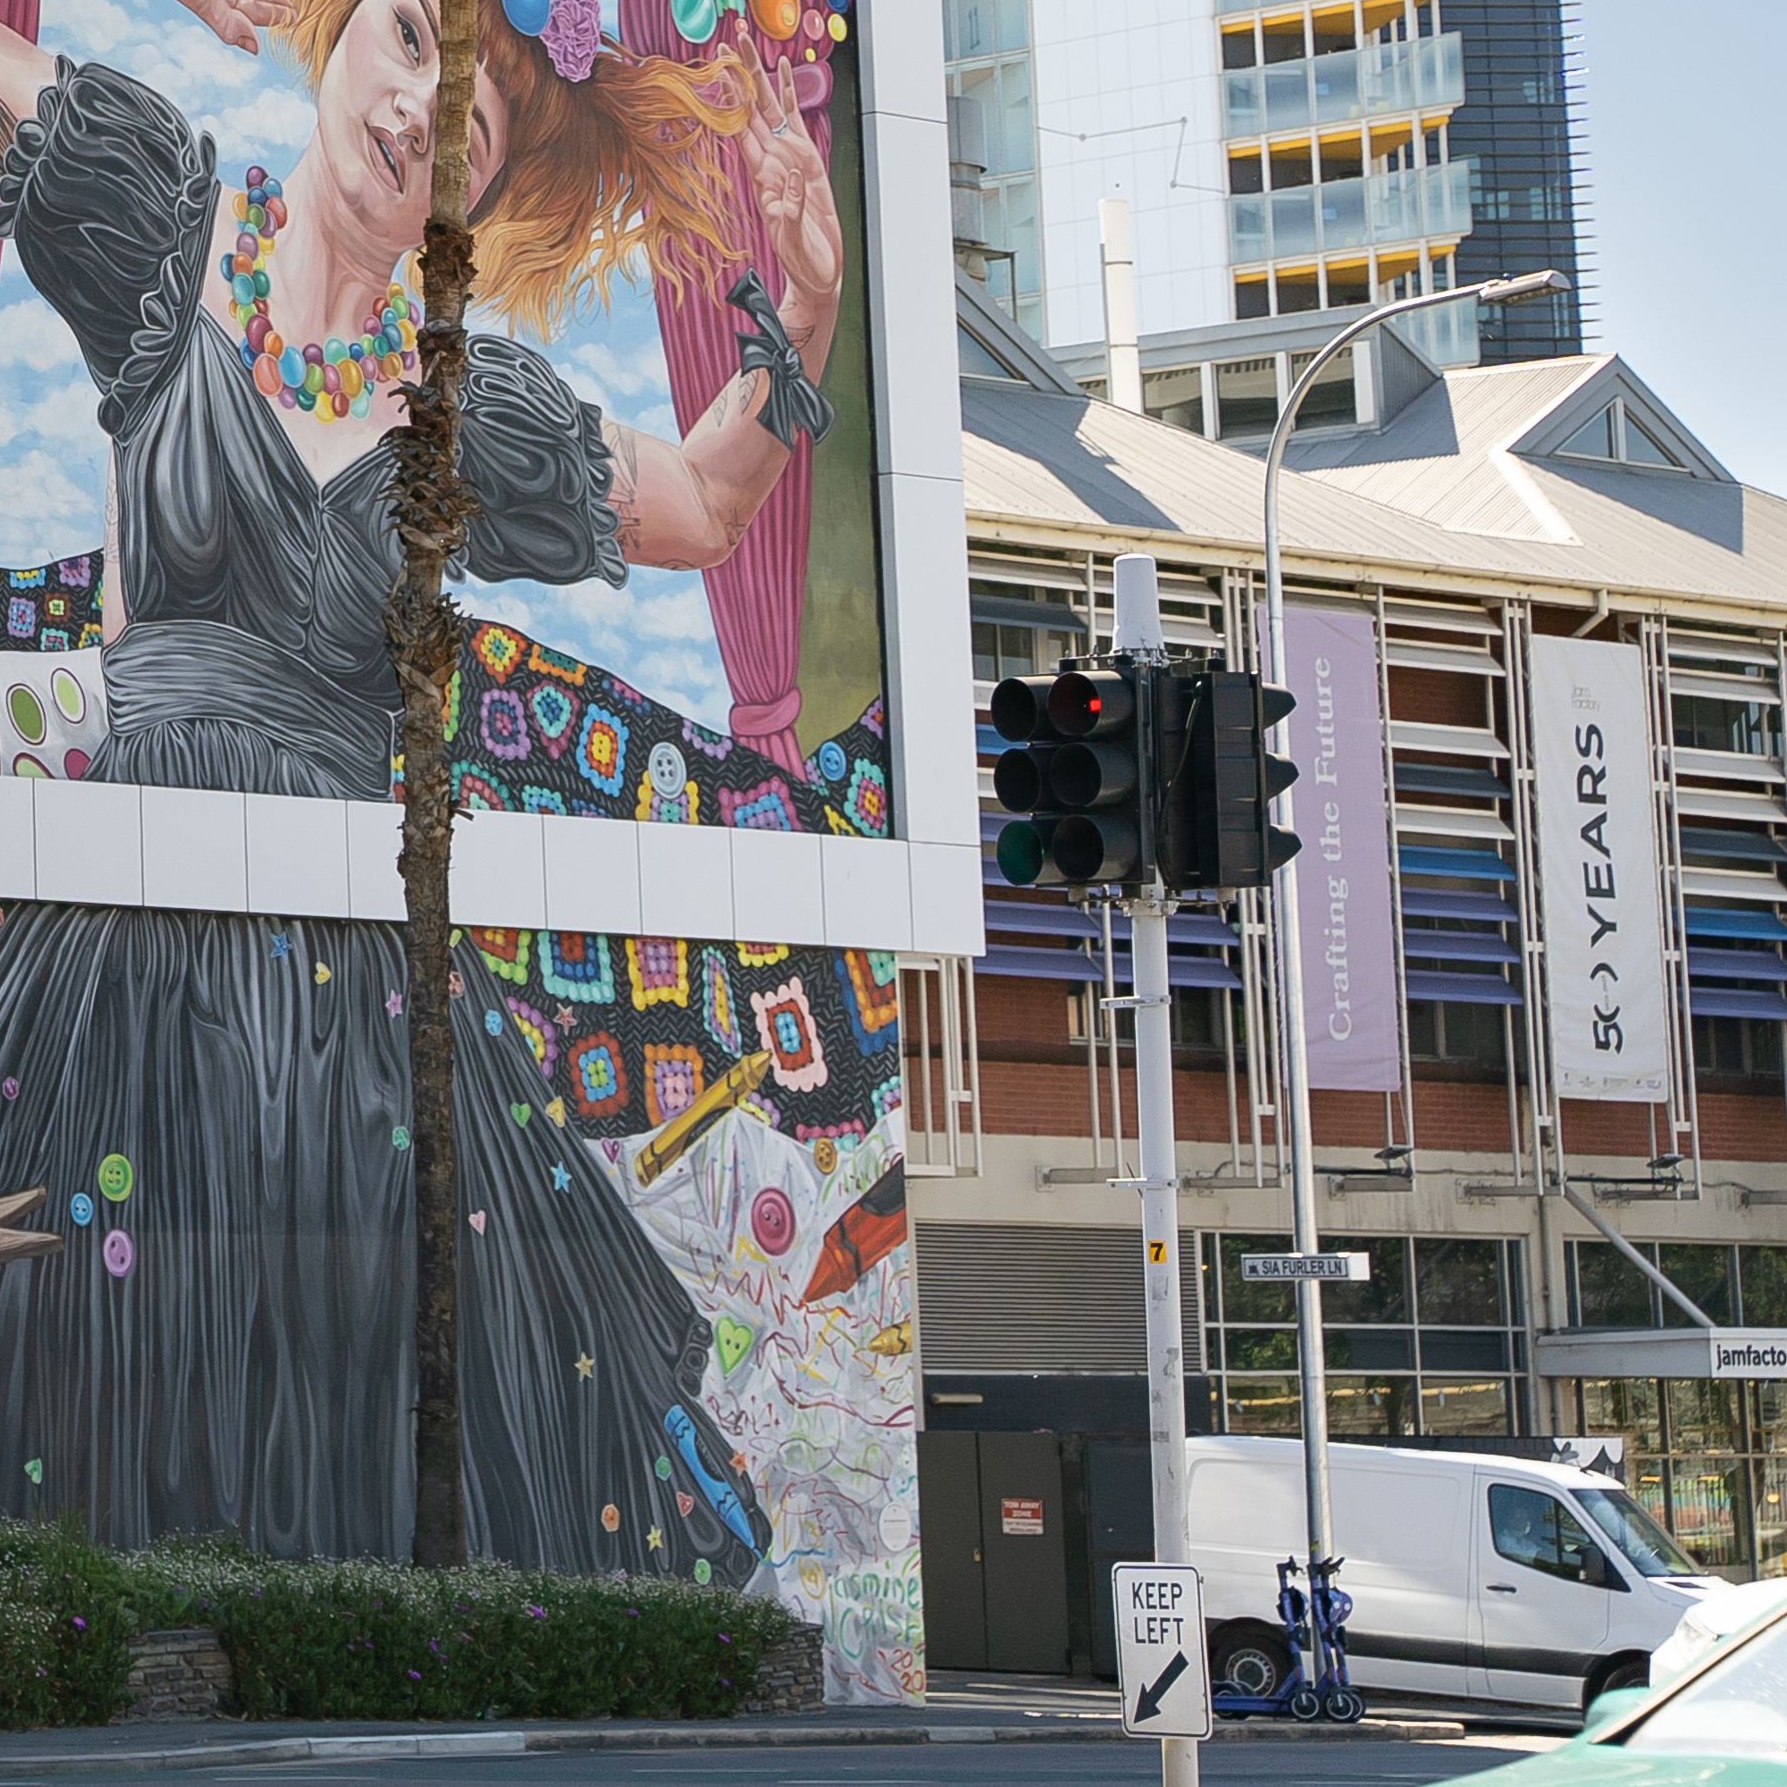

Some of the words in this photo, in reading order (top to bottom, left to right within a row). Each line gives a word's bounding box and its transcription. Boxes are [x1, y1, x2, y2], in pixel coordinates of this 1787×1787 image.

[1315, 657, 1338, 787] Future
[1320, 801, 1341, 864] the
[1575, 723, 1617, 949] YEARS
[1325, 874, 1353, 1042] Crafting
[1150, 1243, 1164, 1262] 7
[1262, 1261, 1280, 1275] SIA
[1282, 1261, 1325, 1275] FURLER
[1328, 1261, 1342, 1274] LN
[1717, 1344, 1787, 1370] jamfacto
[1132, 1582, 1183, 1610] KEEP
[1134, 1617, 1184, 1645] LEFT
[890, 1648, 914, 1673] 20
[900, 1670, 925, 1694] 20
